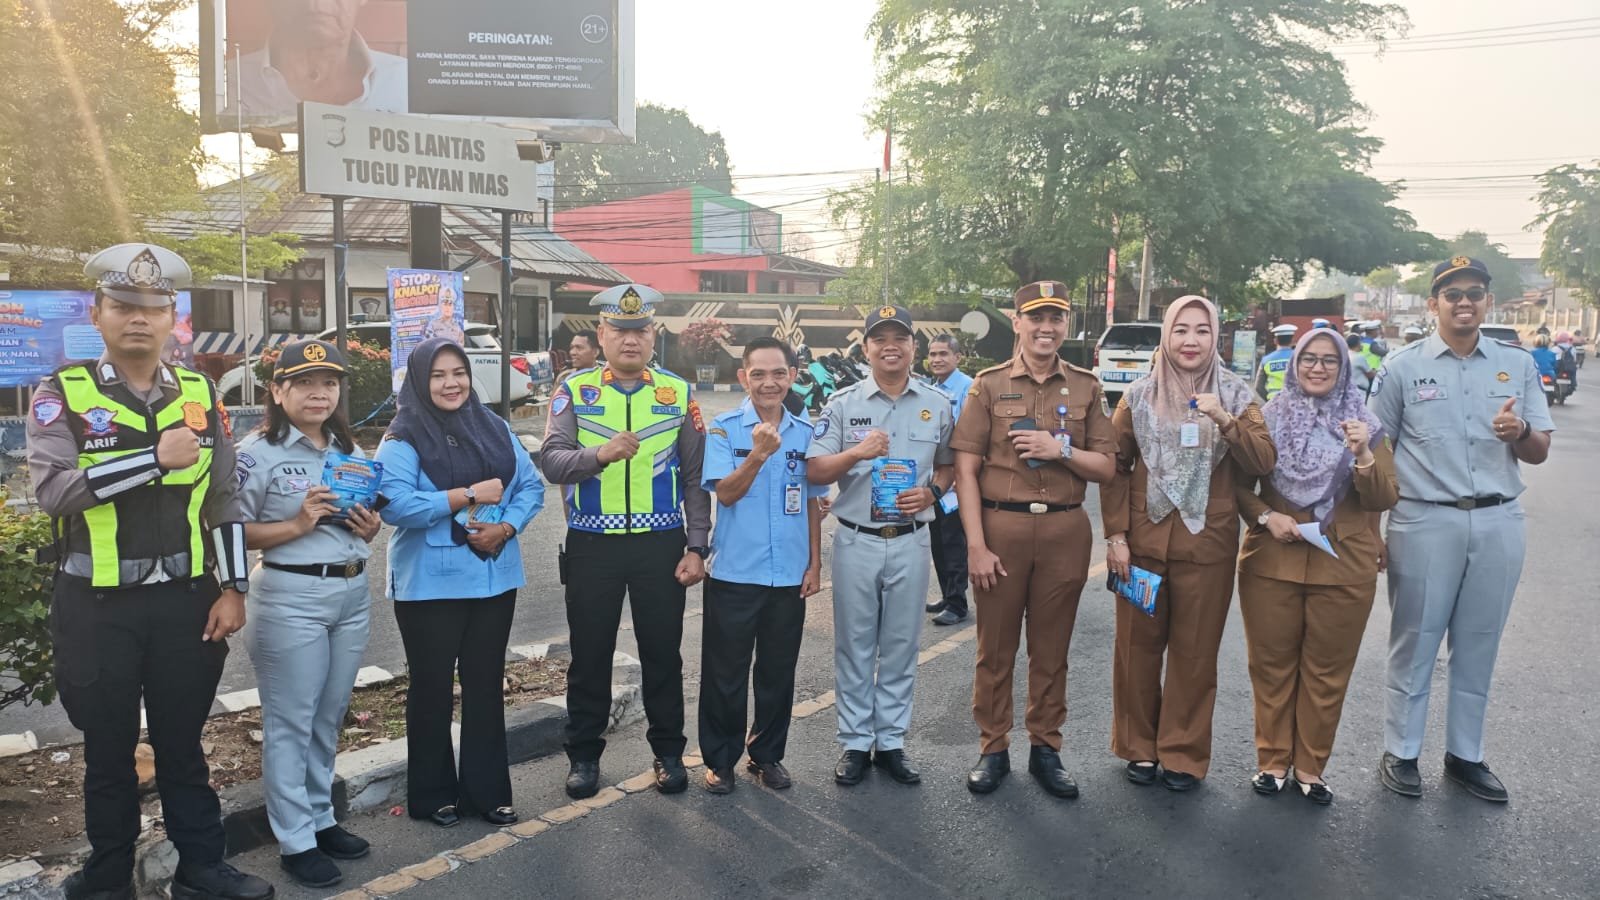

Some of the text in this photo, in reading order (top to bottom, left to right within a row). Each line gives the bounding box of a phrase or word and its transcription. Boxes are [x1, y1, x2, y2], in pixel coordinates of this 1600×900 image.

[584, 23, 605, 34] 21+
[468, 31, 553, 46] PERINGATAN:
[369, 126, 485, 162] POS LANTAS
[342, 158, 509, 197] TUGU PAYAN MAS
[400, 273, 430, 287] STOP
[395, 284, 440, 299] KNALPOT
[1270, 362, 1287, 370] POL
[1101, 371, 1124, 381] POLISI
[1413, 378, 1437, 387] IKA
[850, 417, 872, 426] DWI
[84, 437, 118, 449] ARIF
[282, 467, 307, 475] ULI
